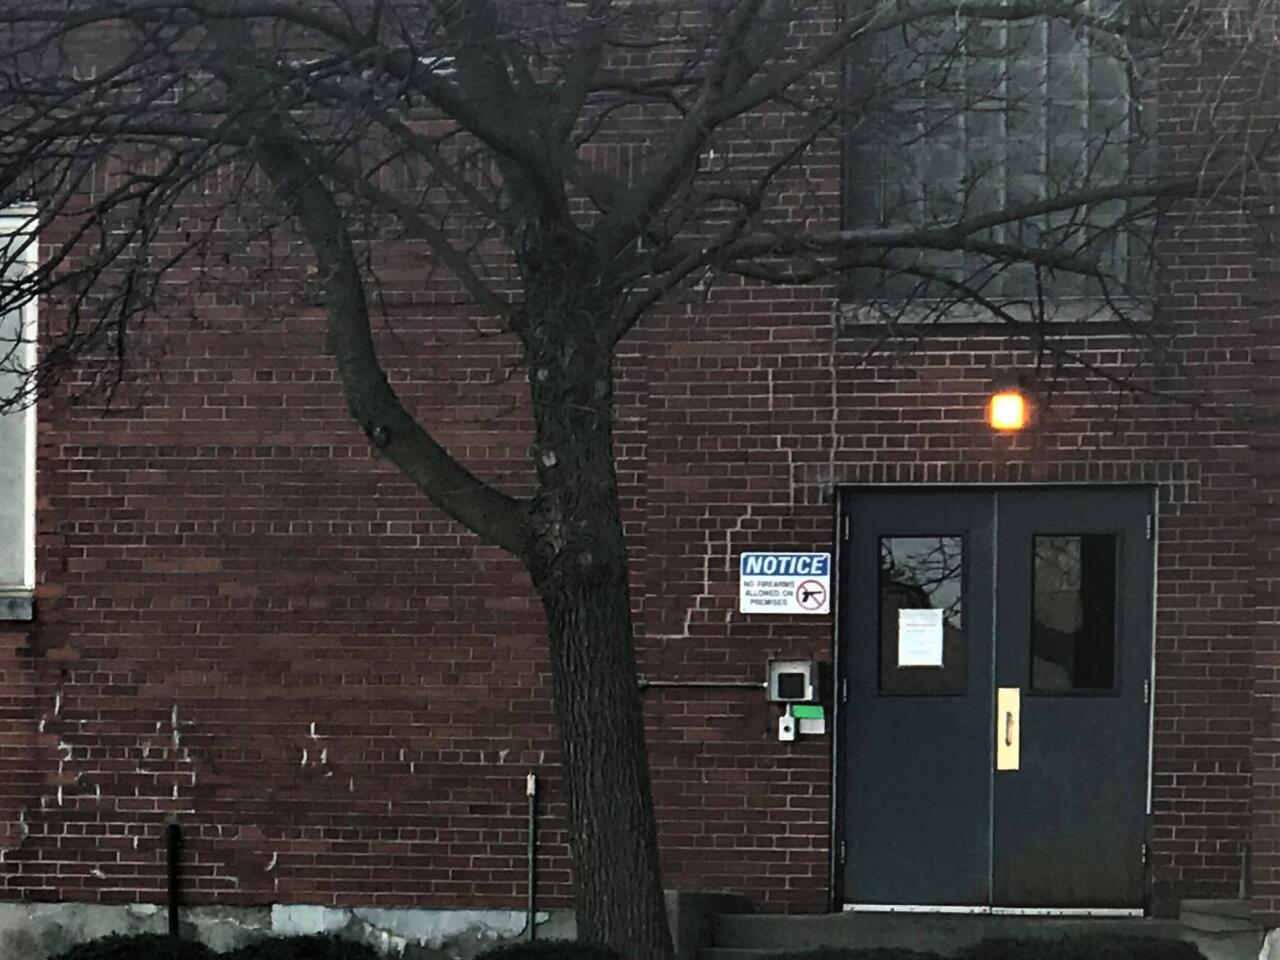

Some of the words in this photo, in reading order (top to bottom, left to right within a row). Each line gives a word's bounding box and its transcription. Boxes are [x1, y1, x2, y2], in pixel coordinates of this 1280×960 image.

[746, 556, 825, 574] NOTICE
[743, 580, 754, 588] NO
[750, 598, 787, 606] PREMISES
